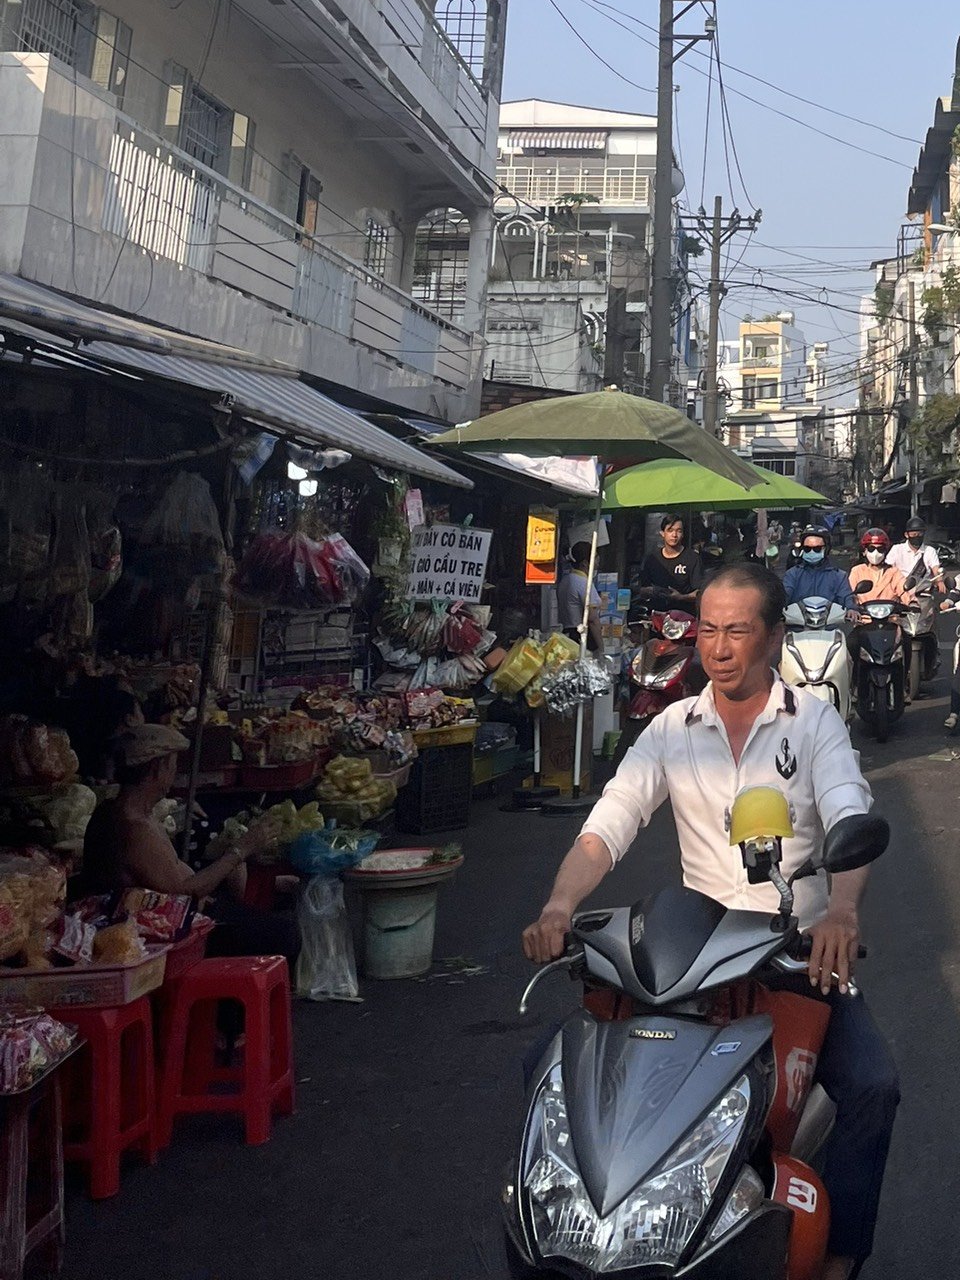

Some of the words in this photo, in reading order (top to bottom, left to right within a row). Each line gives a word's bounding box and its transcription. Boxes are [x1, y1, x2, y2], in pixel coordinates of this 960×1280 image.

[441, 528, 456, 547] CÓ
[458, 532, 482, 551] BÁN
[434, 552, 457, 573] CẦU
[460, 560, 483, 577] TRE
[443, 578, 456, 596] CÁ
[458, 580, 480, 598] VIÊN
